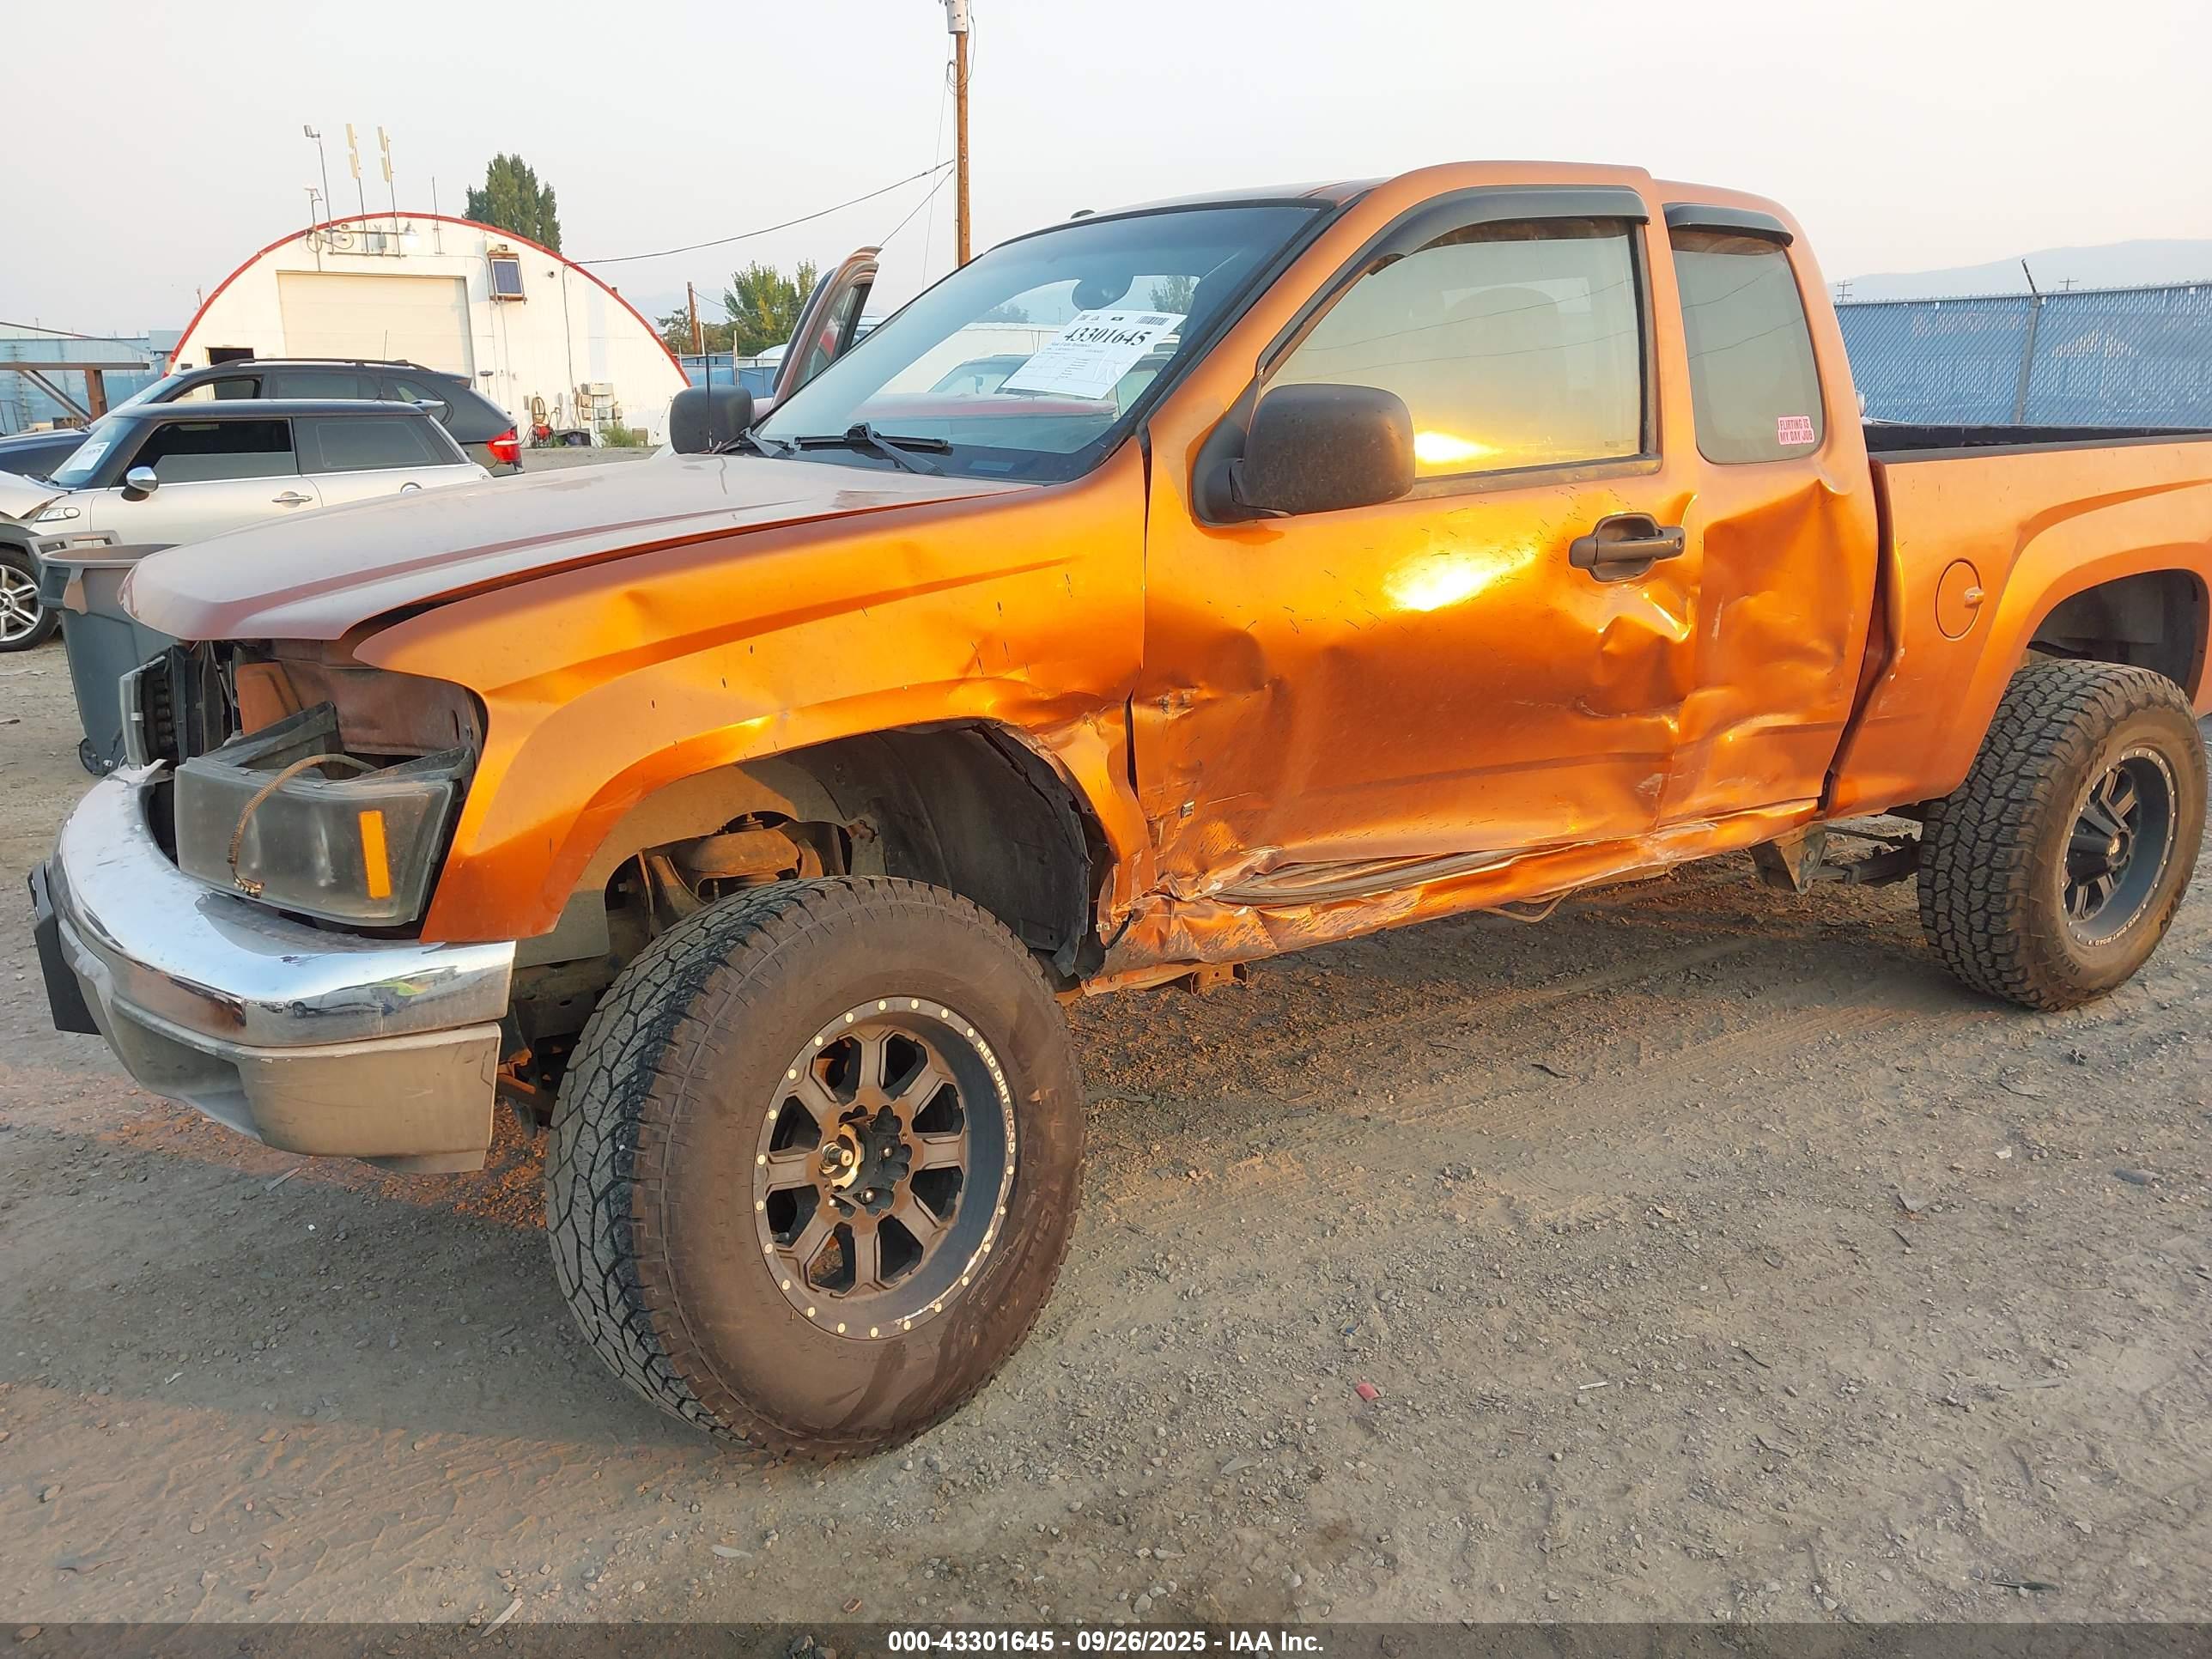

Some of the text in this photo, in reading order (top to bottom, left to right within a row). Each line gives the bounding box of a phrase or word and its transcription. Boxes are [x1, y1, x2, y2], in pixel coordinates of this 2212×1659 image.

[1064, 326, 1153, 346] 43301645
[1780, 418, 1809, 430] FLIRTING IS
[1780, 430, 1813, 442] MY DAY JOB
[976, 1040, 997, 1069] RED
[994, 1069, 1012, 1105] DIRT
